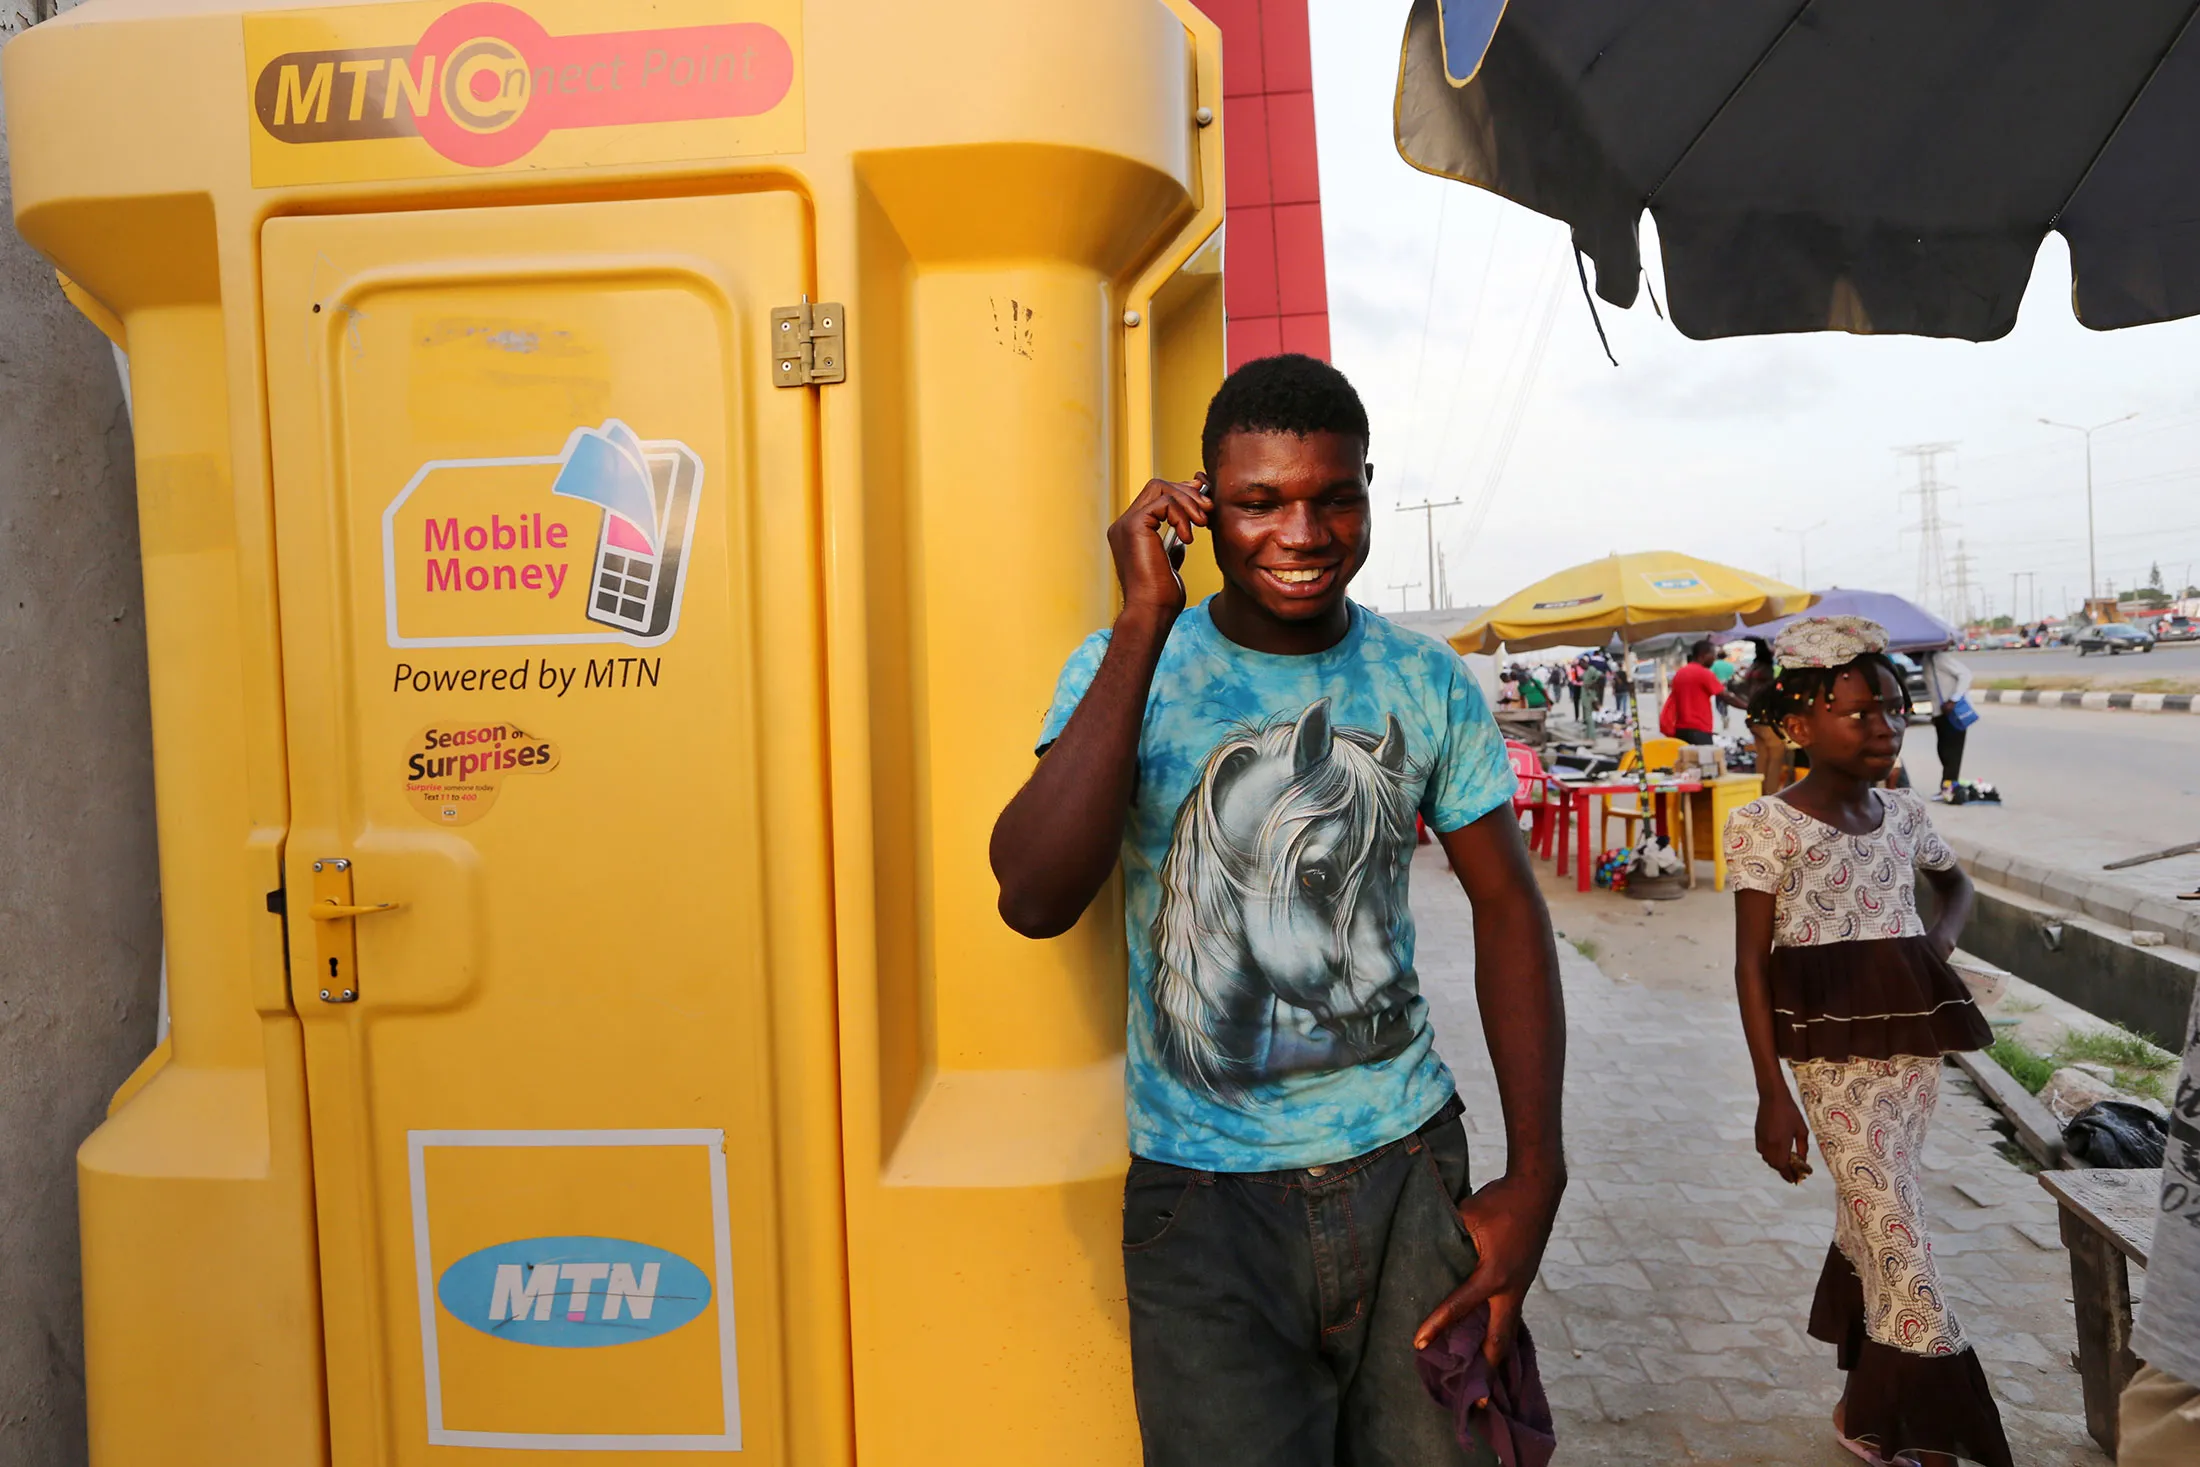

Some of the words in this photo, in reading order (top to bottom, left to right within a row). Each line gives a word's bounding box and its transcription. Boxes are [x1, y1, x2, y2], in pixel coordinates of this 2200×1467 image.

[272, 55, 436, 125] MTN
[641, 45, 758, 87] Point
[425, 513, 568, 552] Mobile
[426, 558, 568, 599] Money
[394, 658, 529, 692] Powered
[538, 658, 576, 697] by
[584, 657, 661, 688] MTN
[425, 725, 506, 750] Season
[408, 743, 550, 782] Surprises
[406, 783, 442, 793] Surprise
[444, 784, 474, 792] someone
[475, 784, 494, 792] today
[424, 793, 439, 801] Text
[452, 793, 460, 801] to
[488, 1263, 661, 1321] MTN
